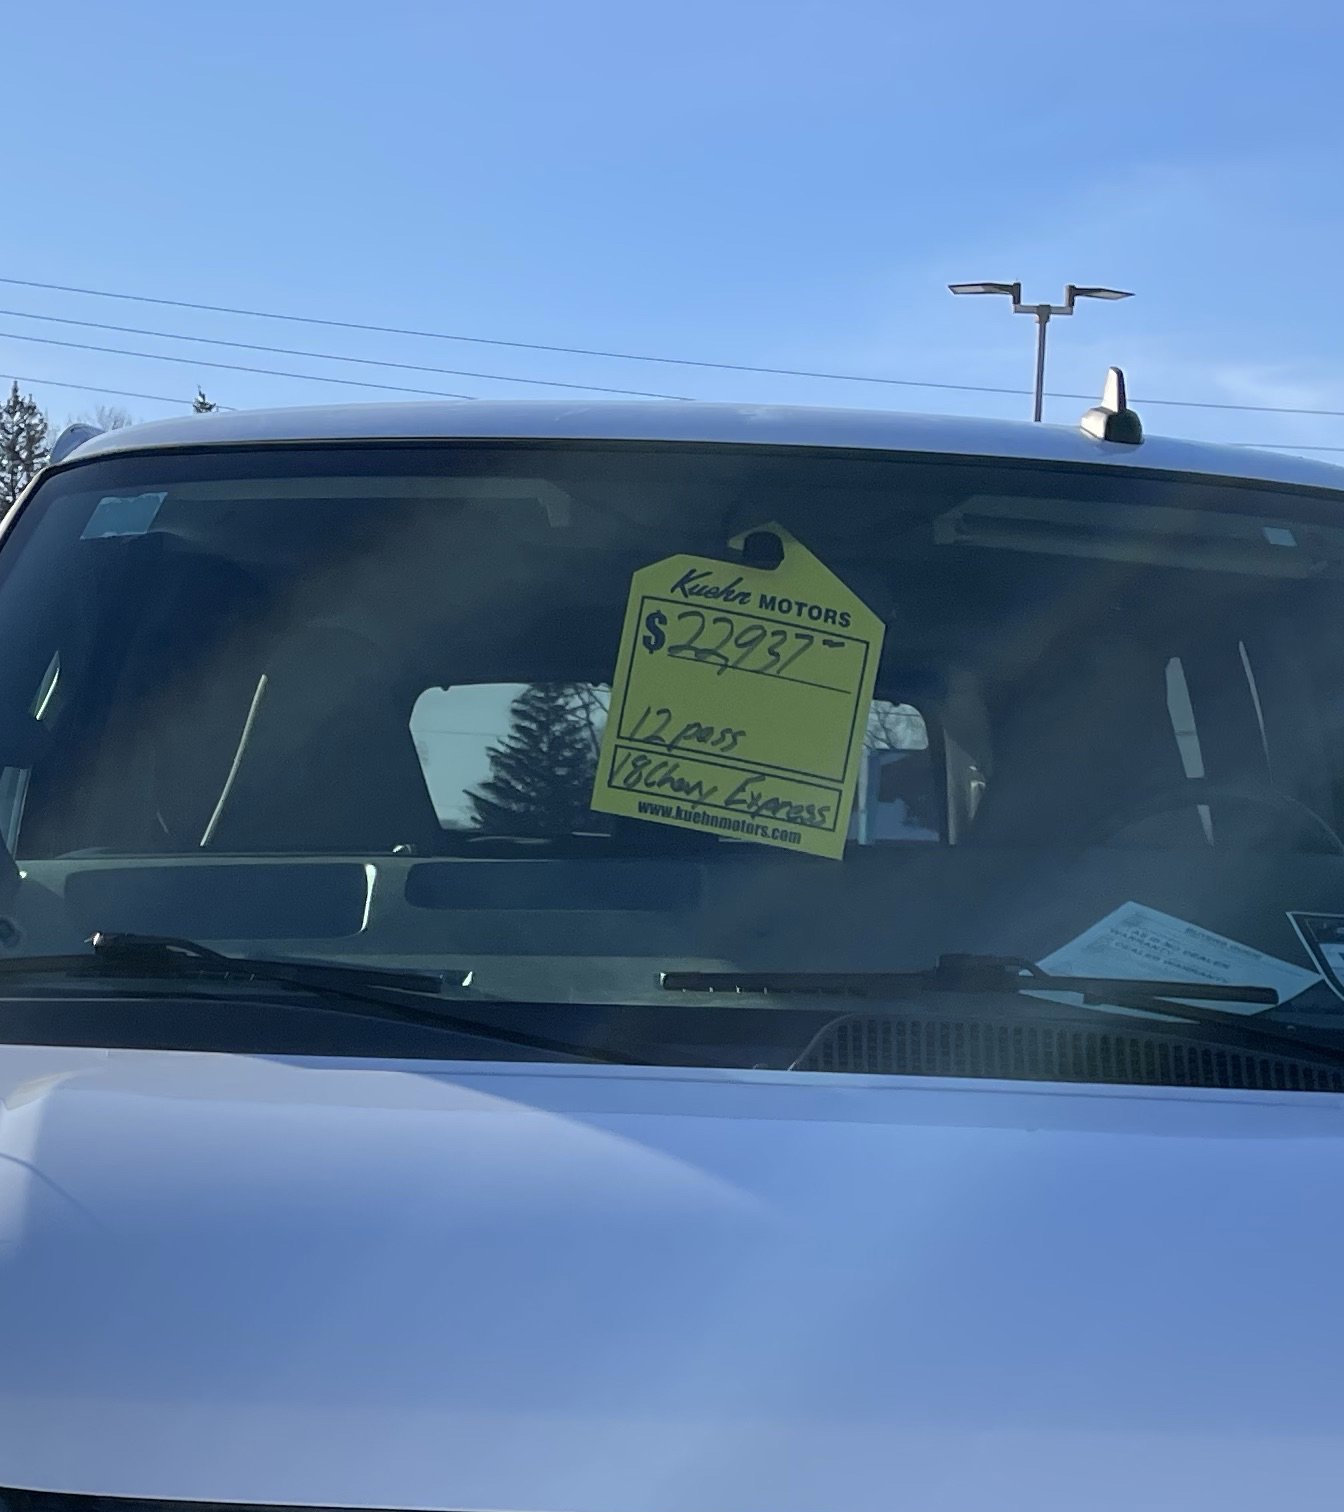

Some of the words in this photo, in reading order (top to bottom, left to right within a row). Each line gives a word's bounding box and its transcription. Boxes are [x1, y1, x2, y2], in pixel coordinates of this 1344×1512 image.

[670, 568, 751, 605] Kuehn
[758, 594, 851, 628] MOTORS
[629, 706, 672, 744] 12
[638, 800, 802, 844] www.kuehnmotors.com
[724, 773, 830, 828] Express
